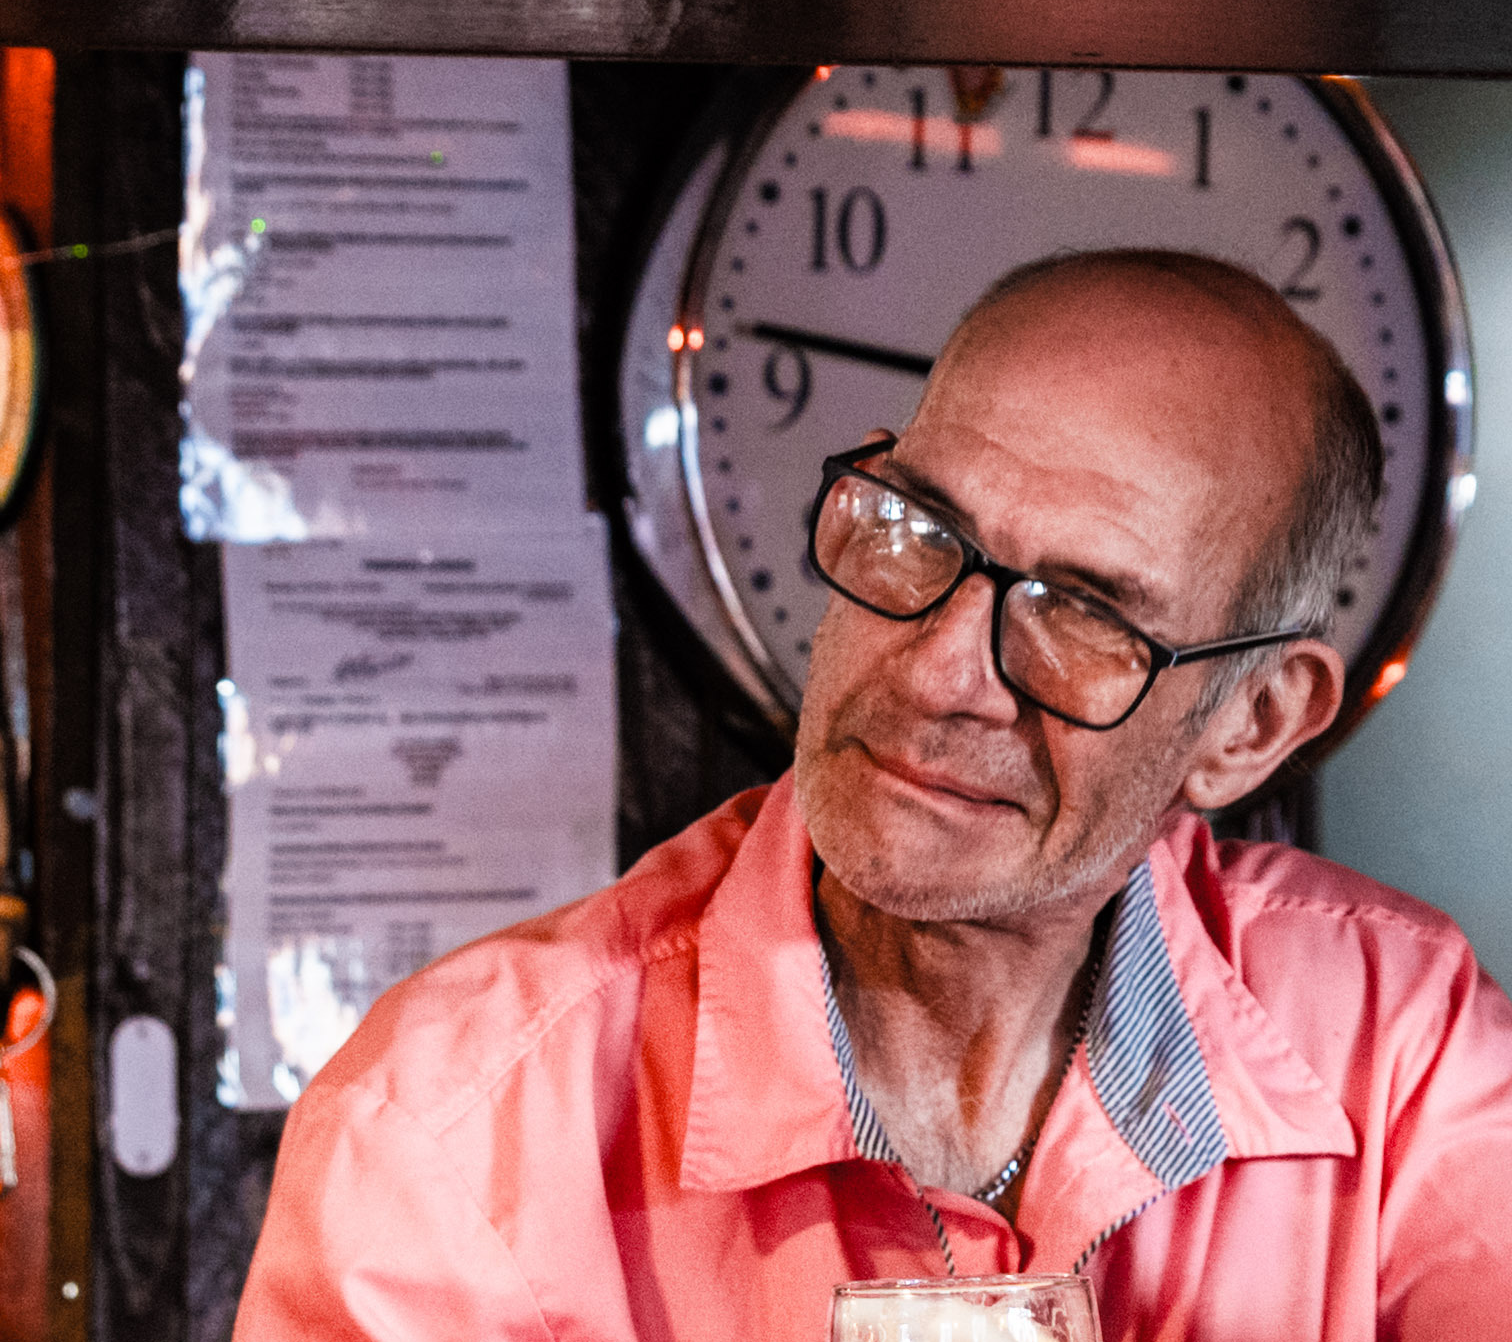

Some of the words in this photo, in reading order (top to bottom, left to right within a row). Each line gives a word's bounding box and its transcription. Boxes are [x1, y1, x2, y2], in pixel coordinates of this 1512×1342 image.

[1035, 70, 1115, 143] 12
[1193, 105, 1212, 191] 1
[807, 186, 887, 276] 10
[1281, 214, 1322, 302] 2
[762, 341, 814, 432] 9
